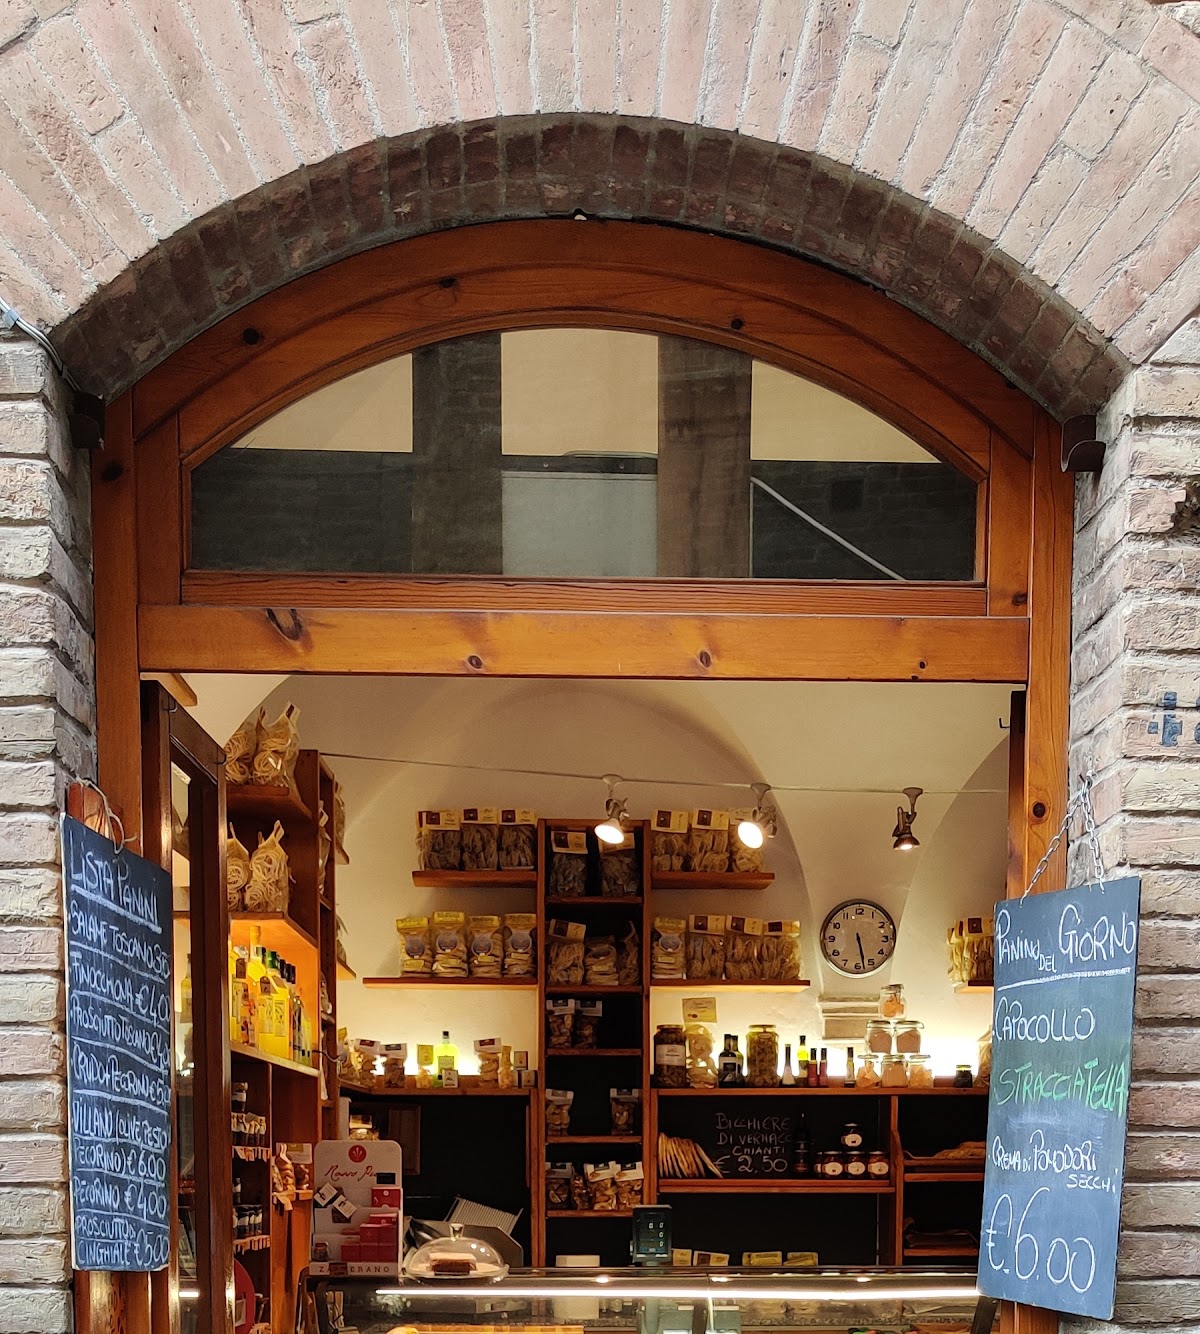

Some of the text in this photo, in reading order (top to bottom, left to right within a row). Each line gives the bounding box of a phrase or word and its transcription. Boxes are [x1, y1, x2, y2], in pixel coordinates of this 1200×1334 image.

[843, 912, 848, 920] 11
[70, 900, 107, 948] SALAME
[833, 922, 840, 930] 10
[995, 904, 1136, 973] PANINO DEL GIORNO
[878, 948, 884, 956] 4
[854, 962, 861, 970] 6
[868, 958, 875, 966] 5
[995, 996, 1095, 1043] CAPOCOLLO
[717, 1132, 733, 1145] DI
[732, 1145, 785, 1156] CHIANTI
[992, 1136, 1021, 1172] CREMA
[1030, 1129, 1097, 1173] POMODORI
[73, 1176, 120, 1209] PECORINO
[78, 1241, 130, 1265] CINGHIALE
